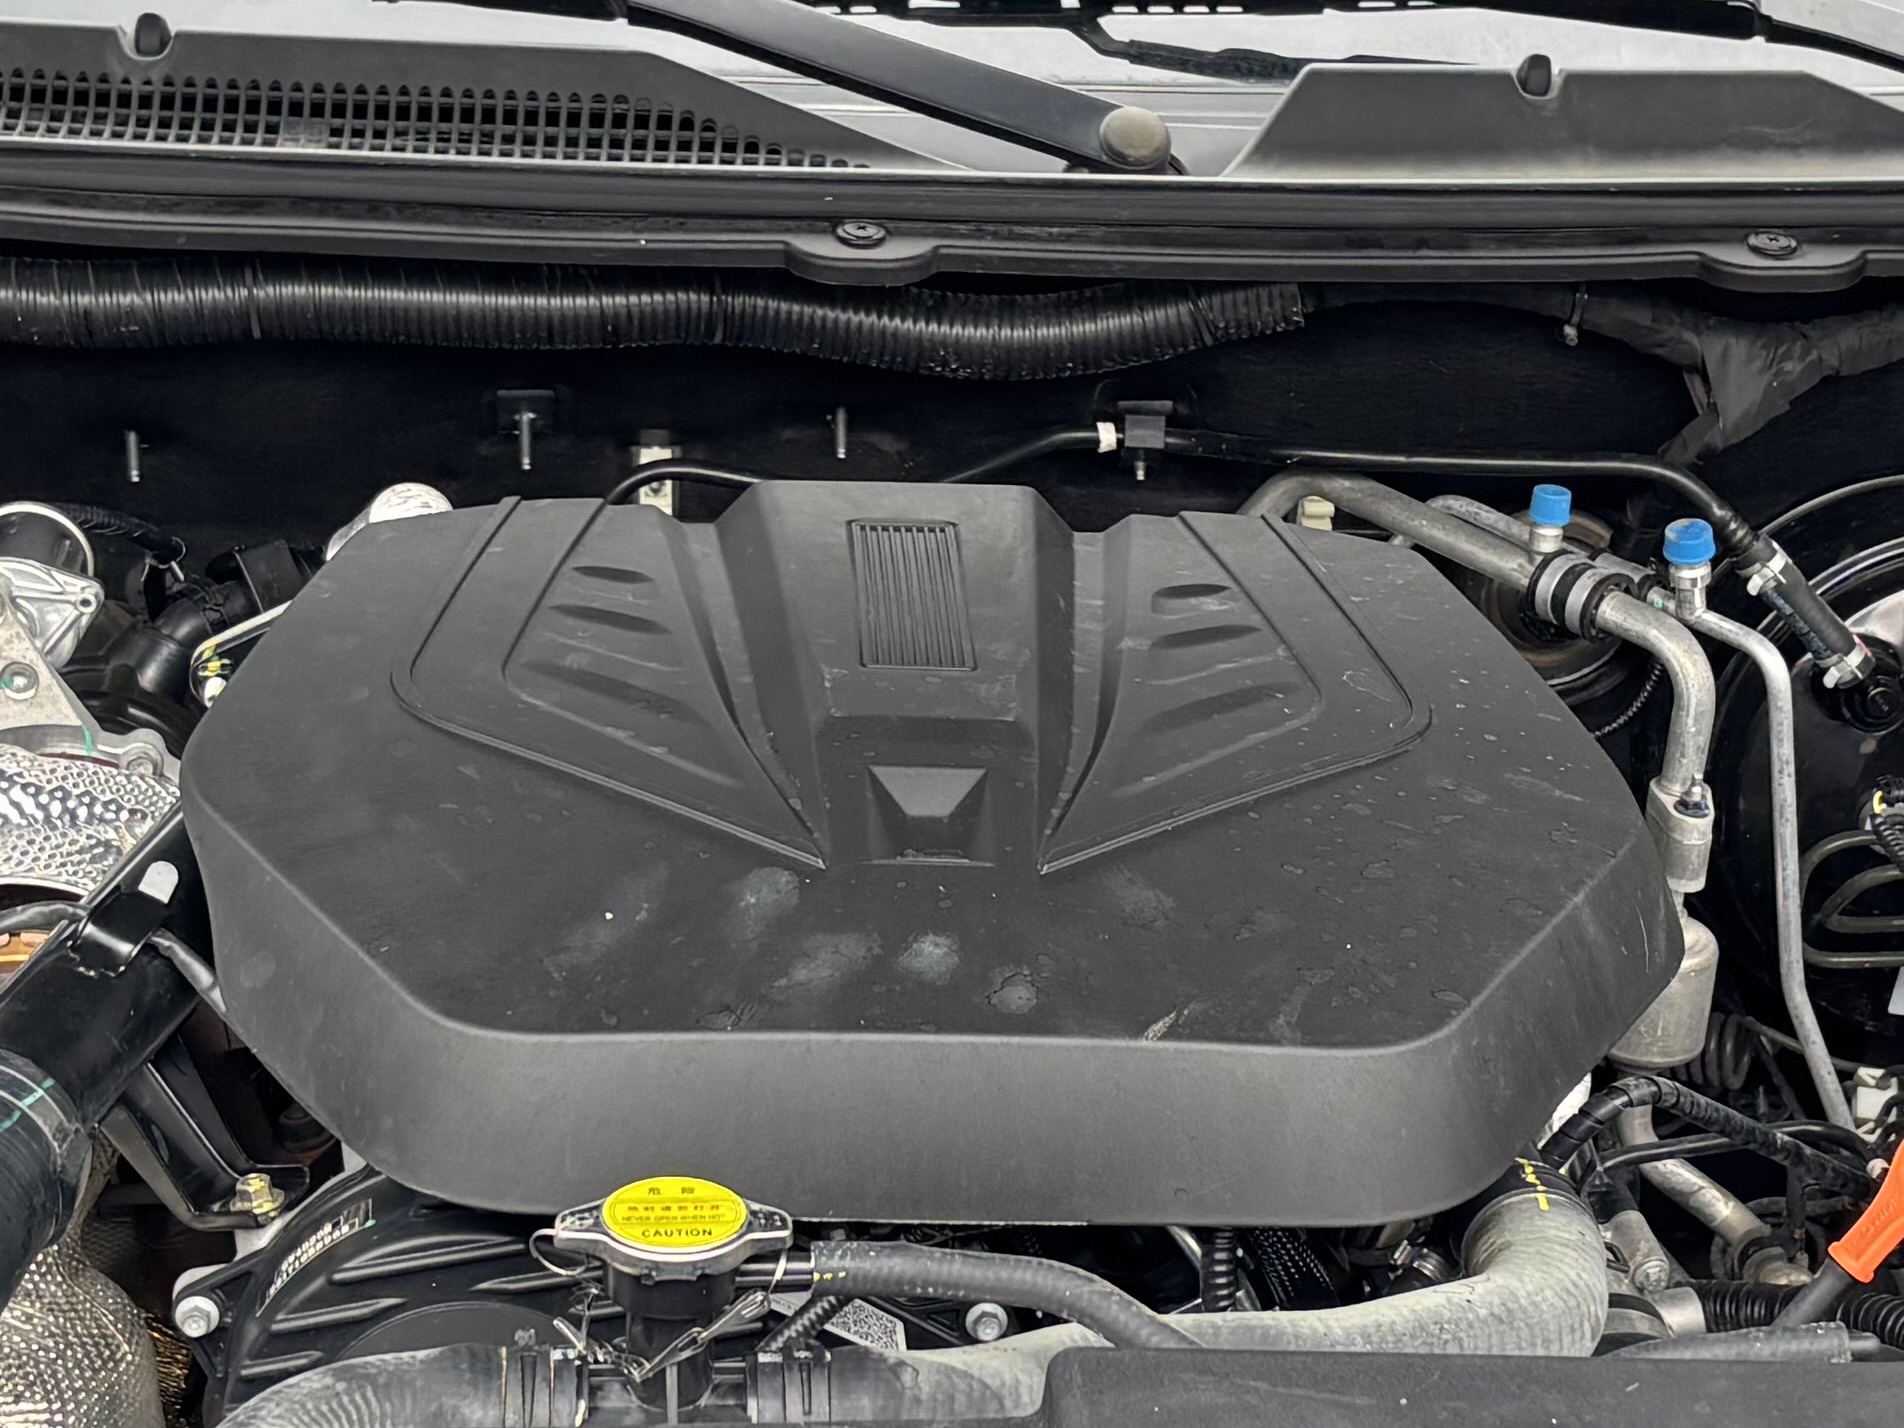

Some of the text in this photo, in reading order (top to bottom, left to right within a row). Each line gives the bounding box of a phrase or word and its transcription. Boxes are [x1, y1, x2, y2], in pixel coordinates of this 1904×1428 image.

[621, 1213, 725, 1222] NEVER OPEN WHEN HOT
[641, 1227, 714, 1238] CAUTION
